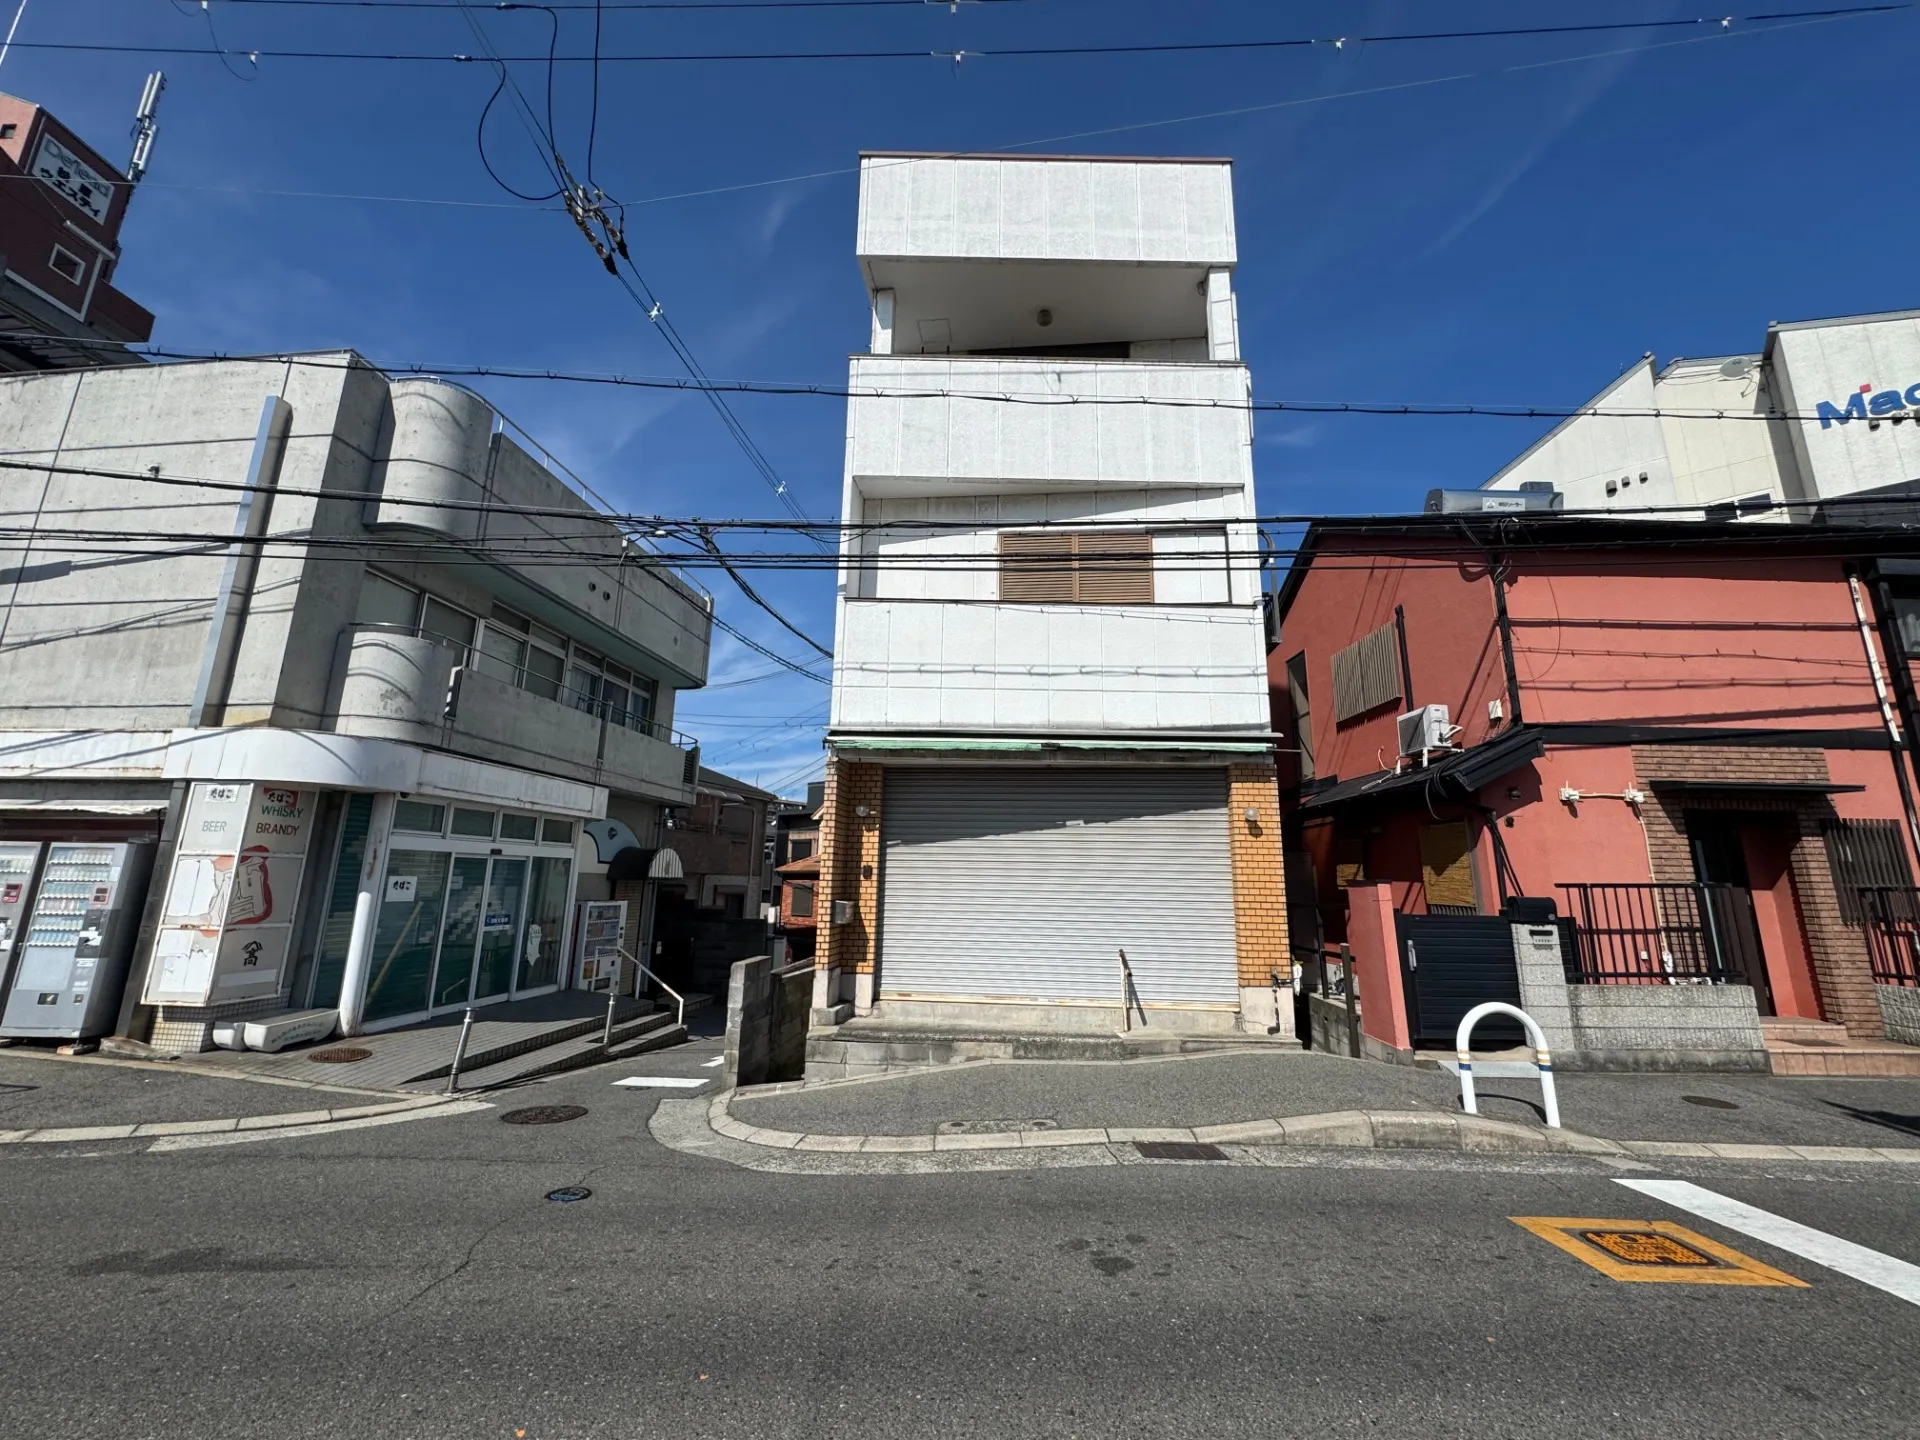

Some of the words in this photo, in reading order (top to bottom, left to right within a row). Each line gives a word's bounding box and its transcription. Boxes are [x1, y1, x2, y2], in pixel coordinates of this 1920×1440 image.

[211, 788, 233, 799] たばこ
[268, 792, 291, 804] たばこ
[261, 805, 304, 818] WHISKY
[202, 821, 227, 833] BEER
[256, 823, 300, 836] BRANDY
[393, 880, 412, 891] たばこ
